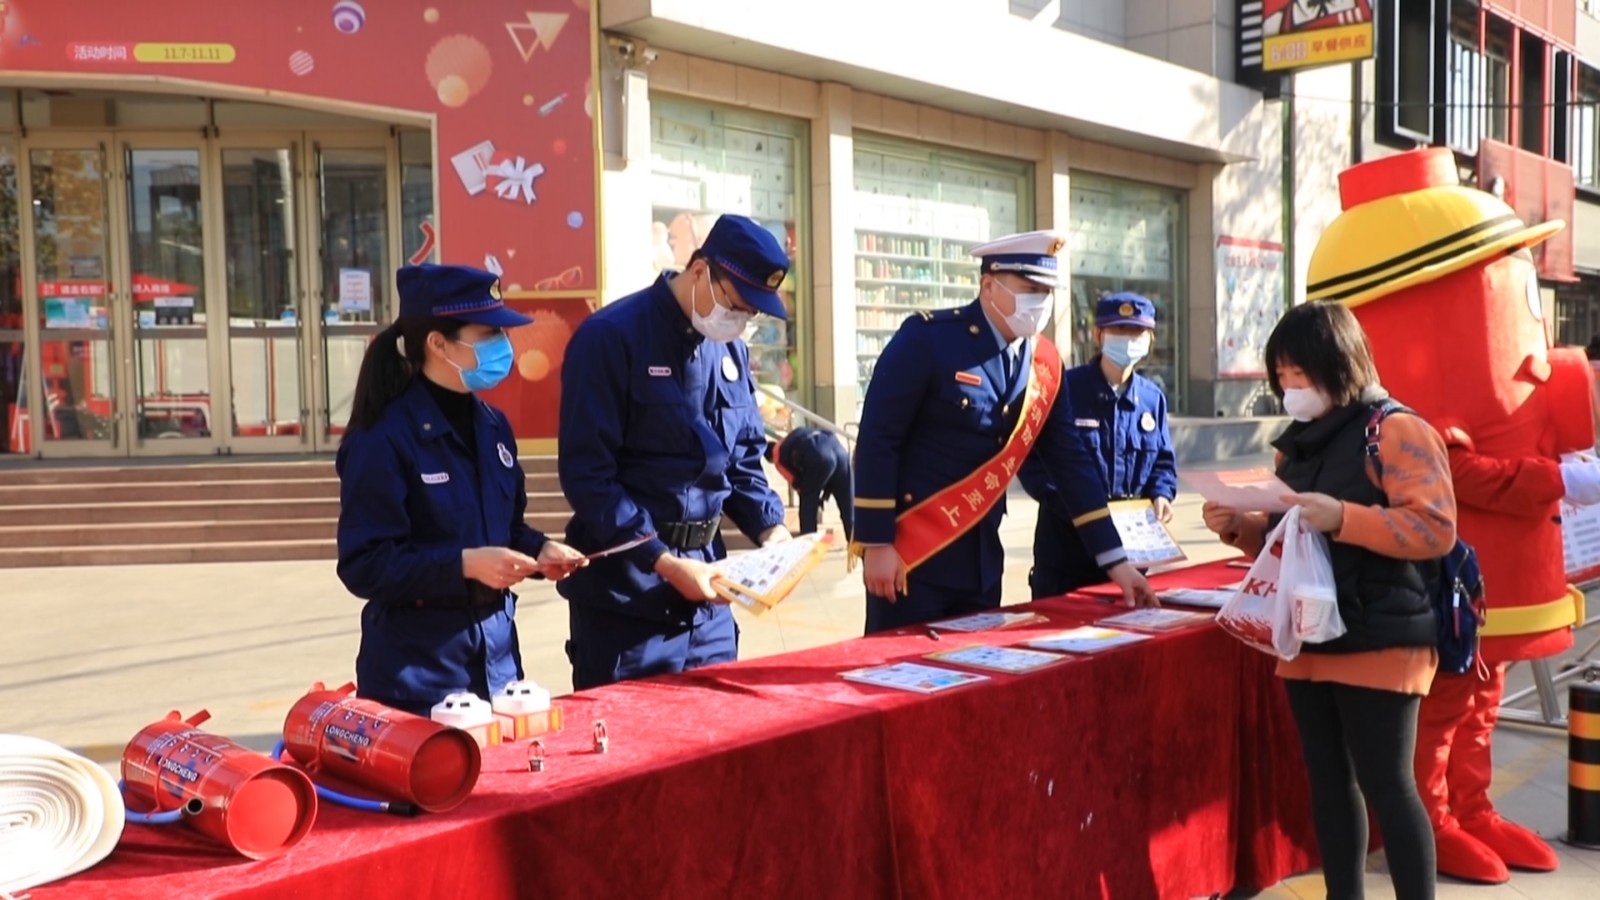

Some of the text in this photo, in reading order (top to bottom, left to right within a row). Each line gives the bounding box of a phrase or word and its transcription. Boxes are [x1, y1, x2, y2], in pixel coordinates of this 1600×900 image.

[74, 45, 221, 60] 活动时间 11.7-11.11
[1312, 35, 1367, 53] 早餐供应
[941, 457, 1016, 527] 生命至上
[325, 725, 369, 746] LONGCHENG
[158, 757, 198, 782] LONGCHENG
